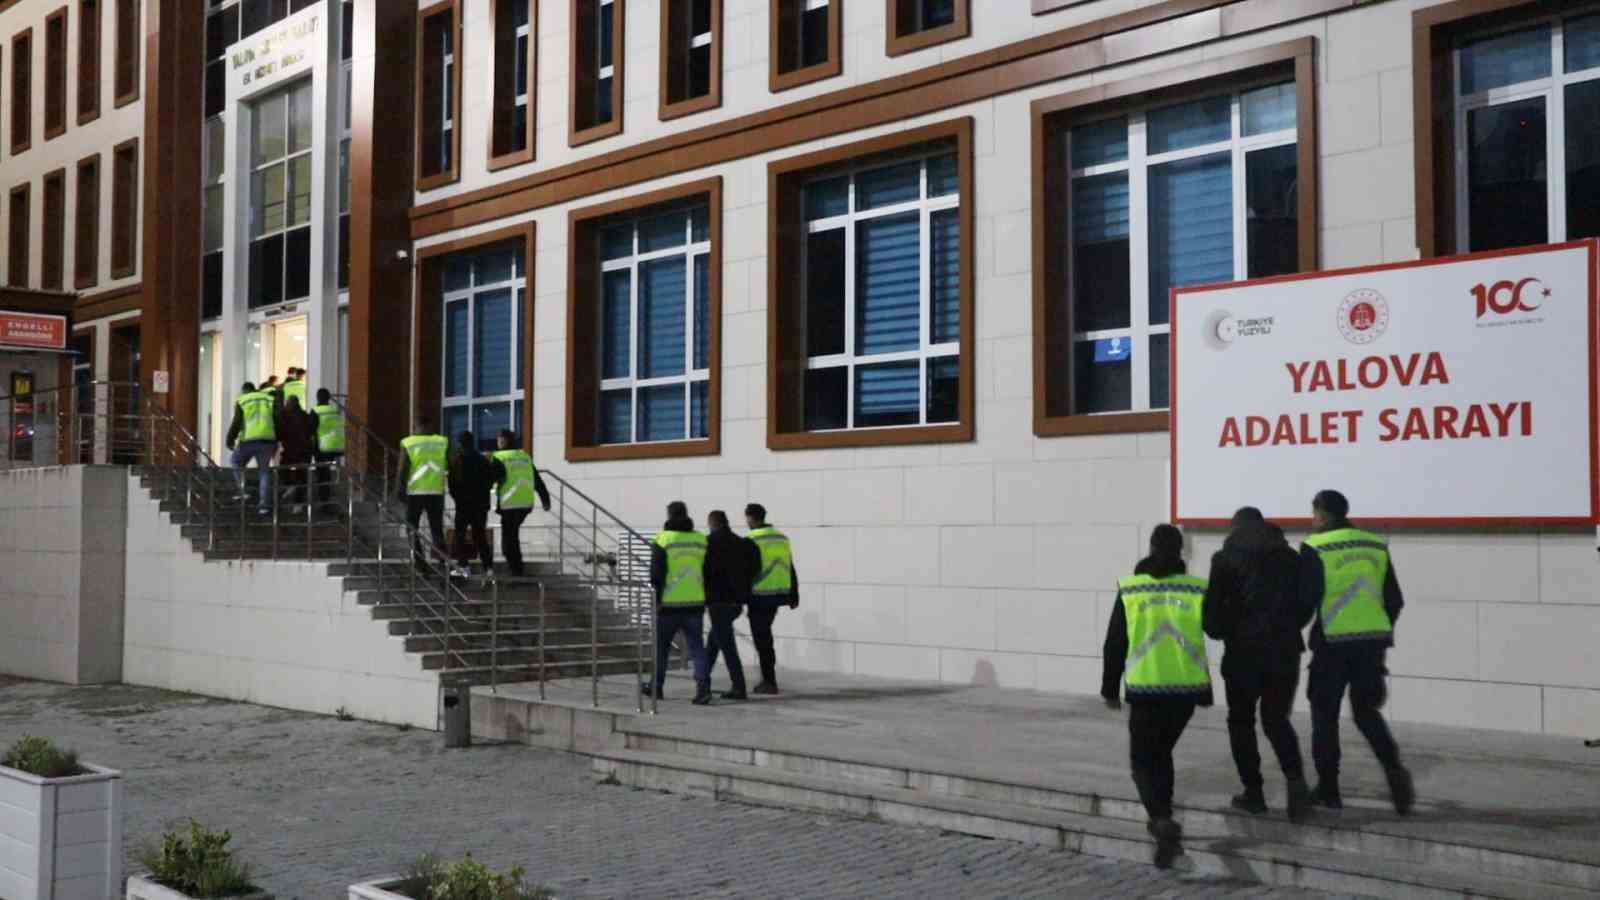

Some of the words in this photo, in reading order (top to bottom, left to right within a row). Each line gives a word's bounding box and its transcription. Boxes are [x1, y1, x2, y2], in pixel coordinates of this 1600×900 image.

[1285, 351, 1449, 393] YALOVA
[1218, 410, 1363, 448] ADALET
[1378, 401, 1532, 442] SARAYI
